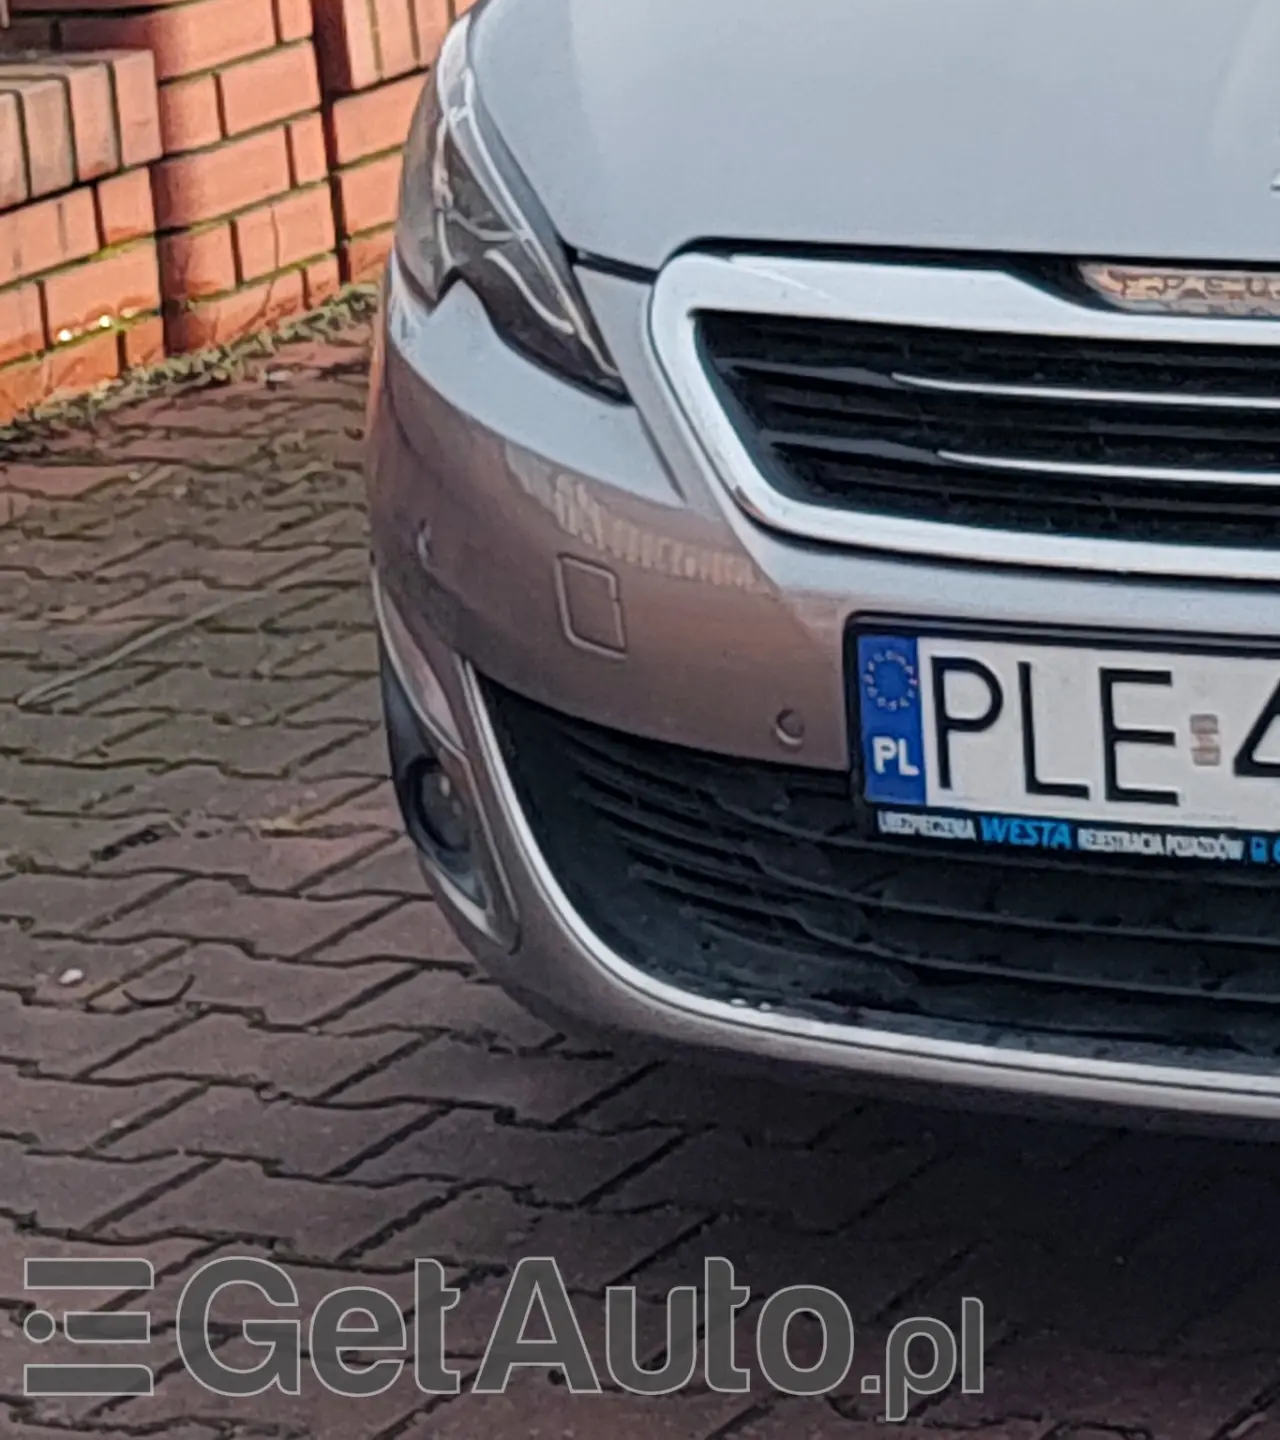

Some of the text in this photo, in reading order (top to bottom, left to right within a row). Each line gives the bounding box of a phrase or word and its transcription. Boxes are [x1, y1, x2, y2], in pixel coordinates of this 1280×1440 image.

[929, 655, 1180, 807] PLE
[872, 736, 920, 777] PL
[979, 815, 1072, 850] WESTA
